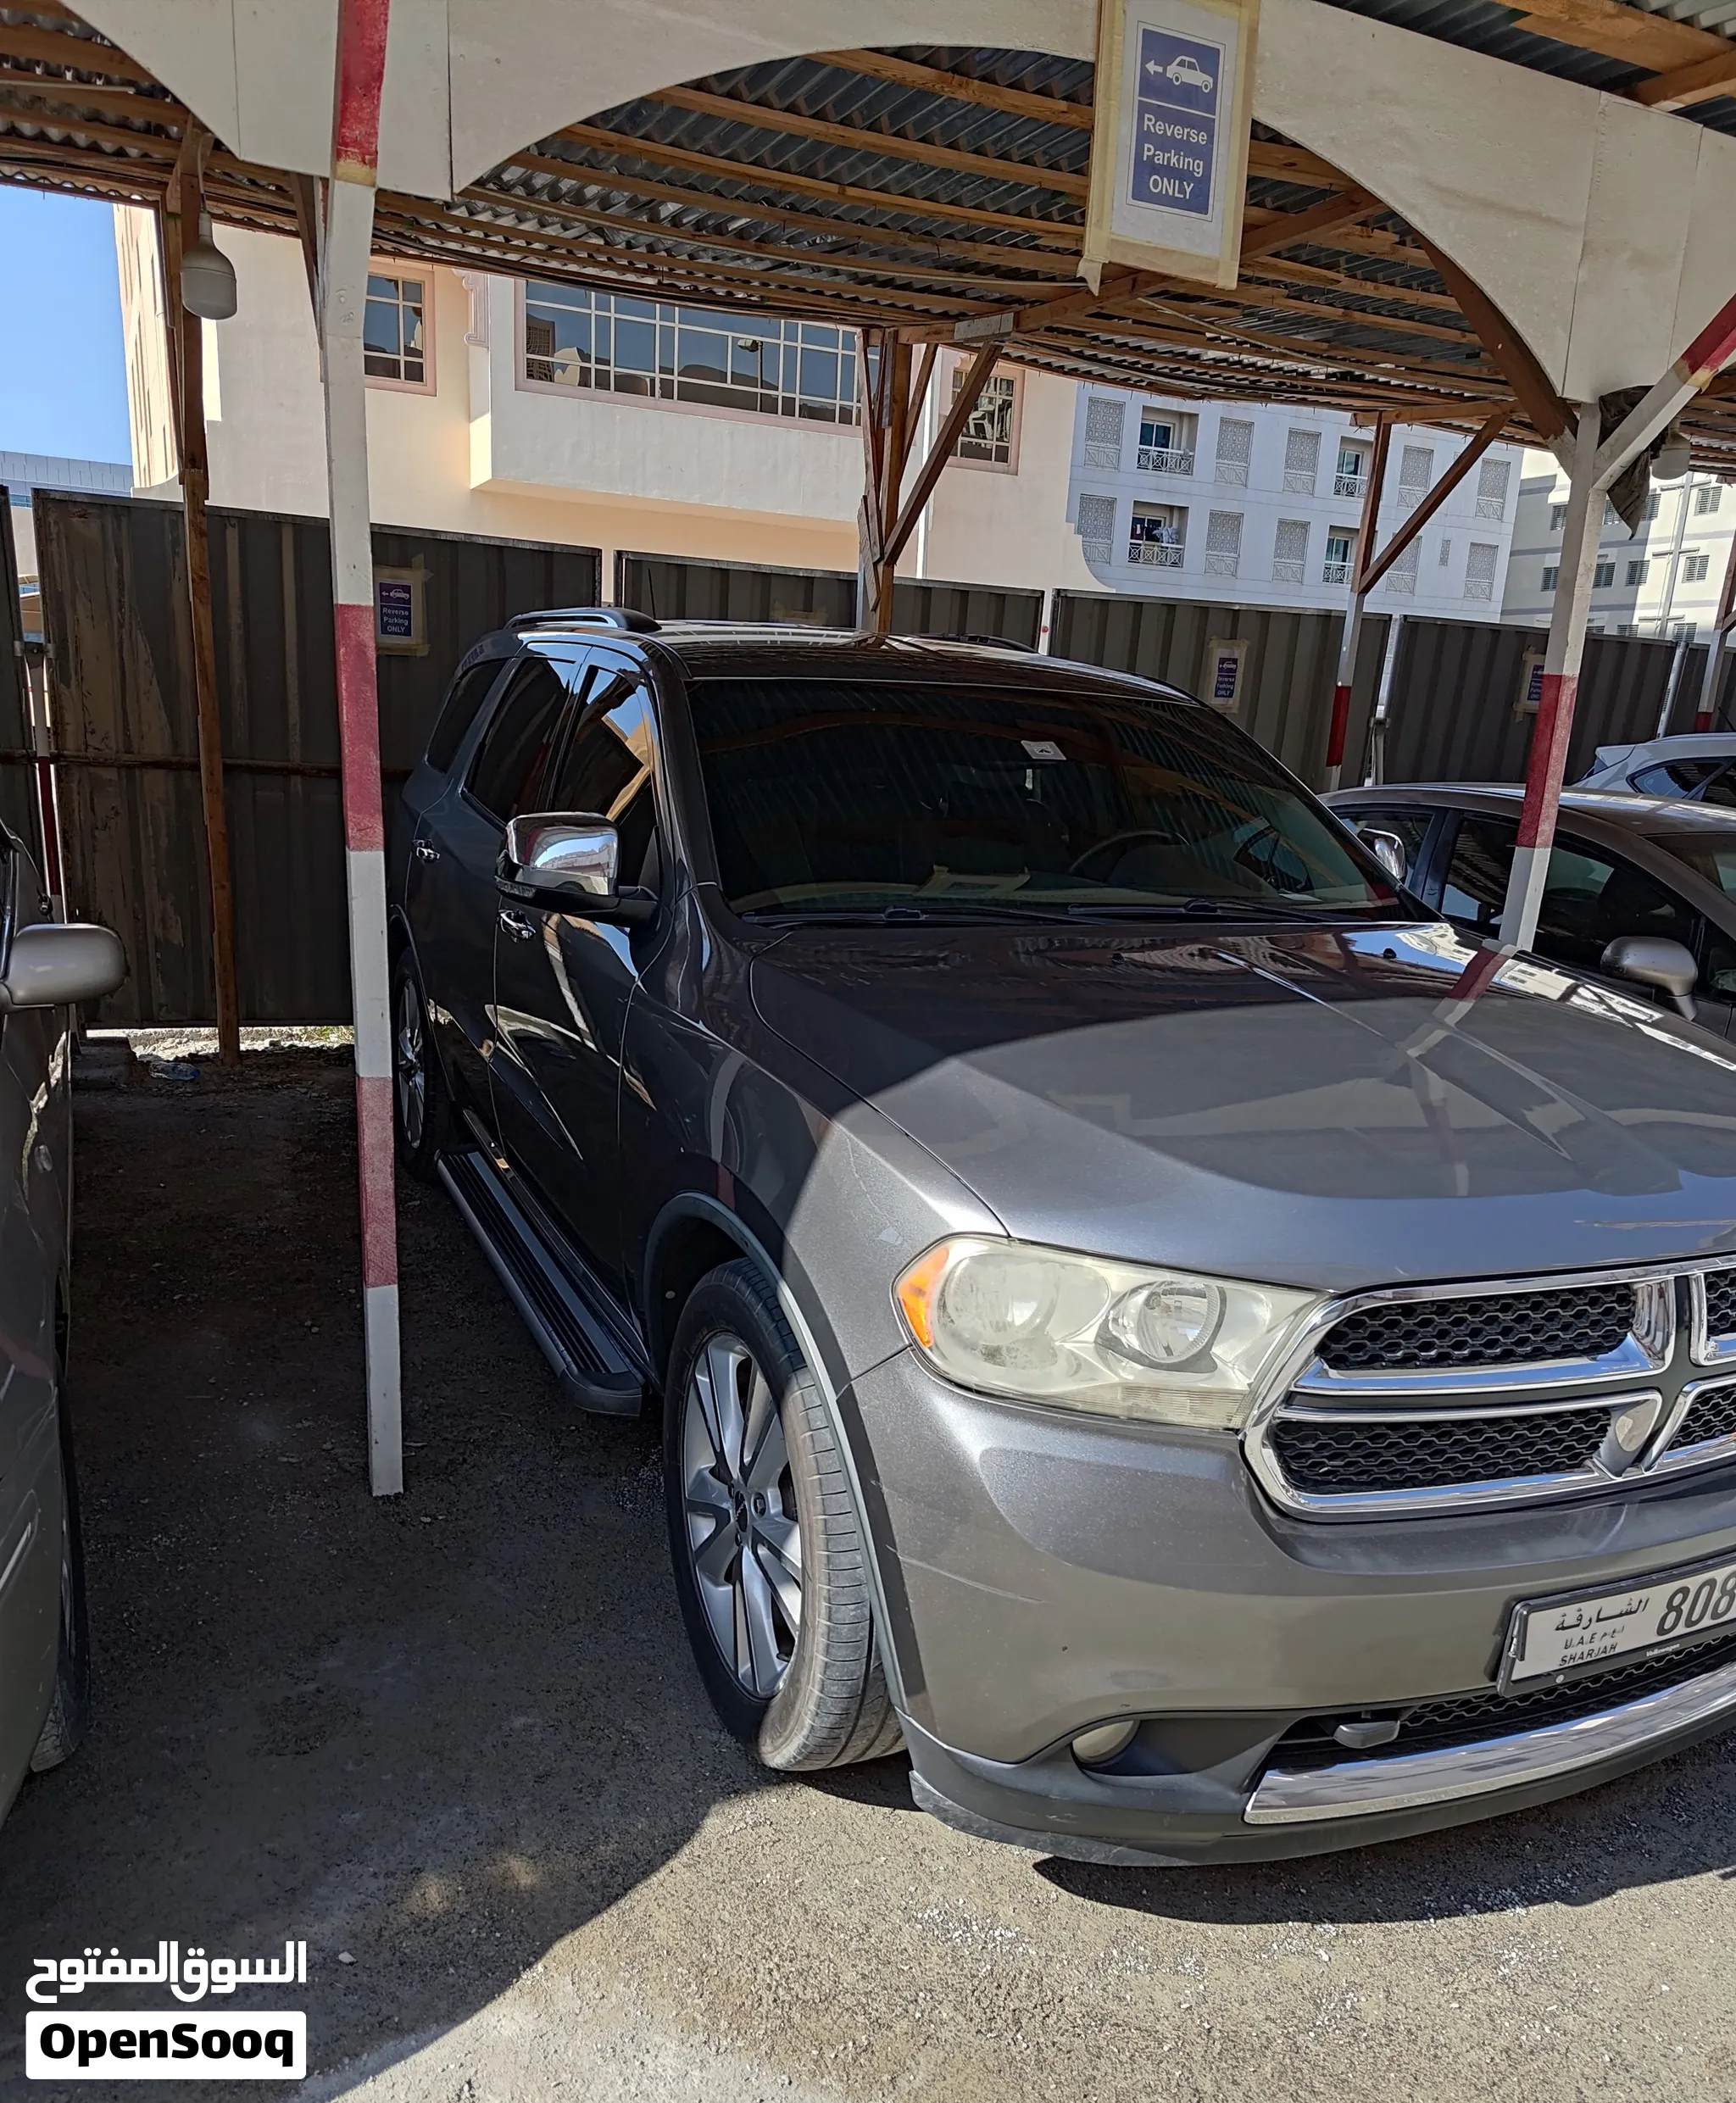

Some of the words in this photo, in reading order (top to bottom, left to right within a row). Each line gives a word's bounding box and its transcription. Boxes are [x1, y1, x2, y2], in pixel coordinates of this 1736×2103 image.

[1143, 113, 1207, 144] Reverse
[1143, 143, 1204, 177] Parking
[1149, 175, 1194, 199] ONLY
[382, 607, 409, 615] Reverse
[383, 616, 409, 626] Parking
[1555, 1597, 1650, 1632] الشارقة
[1559, 1642, 1618, 1666] SHARJAH
